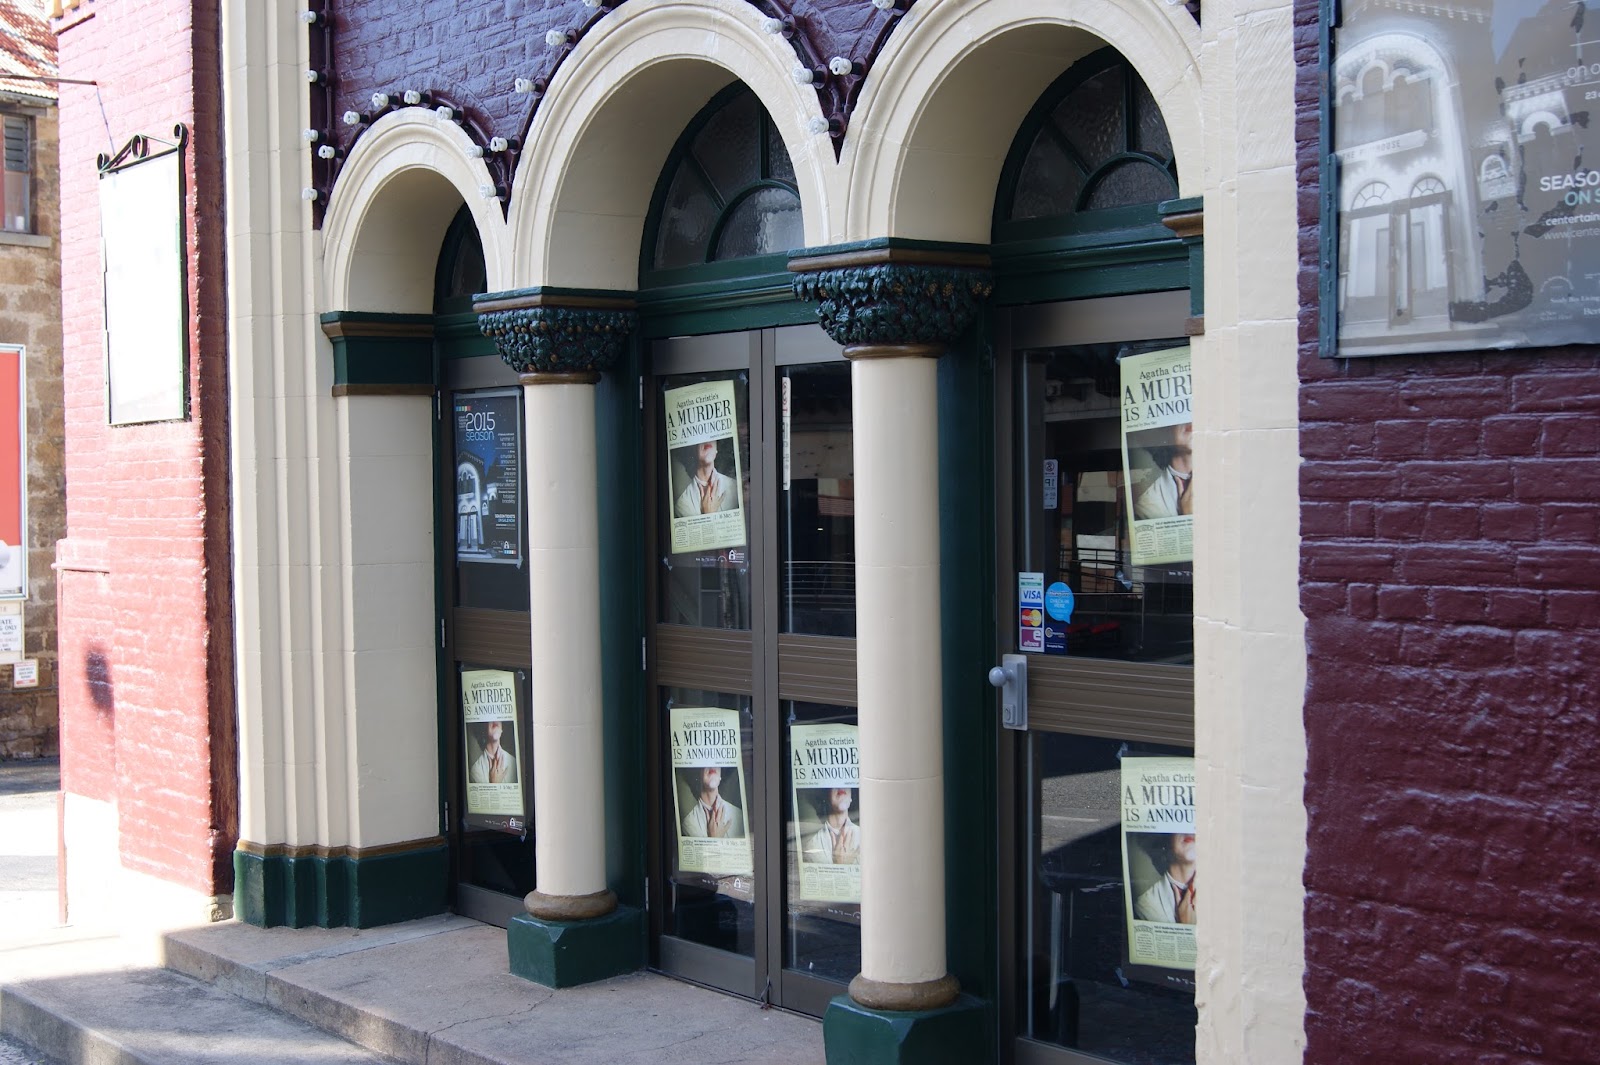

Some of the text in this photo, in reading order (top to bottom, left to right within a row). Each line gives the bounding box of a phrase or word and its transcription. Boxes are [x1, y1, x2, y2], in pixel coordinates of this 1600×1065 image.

[1540, 171, 1600, 191] SEASO
[1564, 190, 1591, 206] ON
[1545, 212, 1600, 226] centertain
[1543, 227, 1600, 240] www.cente
[1139, 365, 1169, 379] Agatha
[1123, 374, 1192, 406] A MUR
[676, 392, 719, 409] Agatha Christie's
[667, 399, 732, 429] A MURDER
[1124, 400, 1192, 422] IS ANNOU
[465, 411, 496, 431] 2015
[465, 430, 495, 442] season
[668, 429, 678, 441] IS
[681, 418, 733, 439] ANNOUNCED
[1023, 590, 1041, 599] VISA
[463, 688, 512, 704] A MURDER
[464, 704, 513, 716] IS ANNOUNCED
[683, 720, 725, 729] Agatha Christie's
[673, 729, 737, 746] A MURDER
[805, 737, 855, 747] Agatha Christie's
[673, 748, 737, 759] IS ANNOUNCED
[793, 747, 859, 766] A MURDE
[794, 767, 859, 780] IS ANNOUNC
[1140, 773, 1195, 784] Agatha Chris
[1124, 785, 1195, 806] A MUR
[1125, 808, 1196, 823] IS ANNOU
